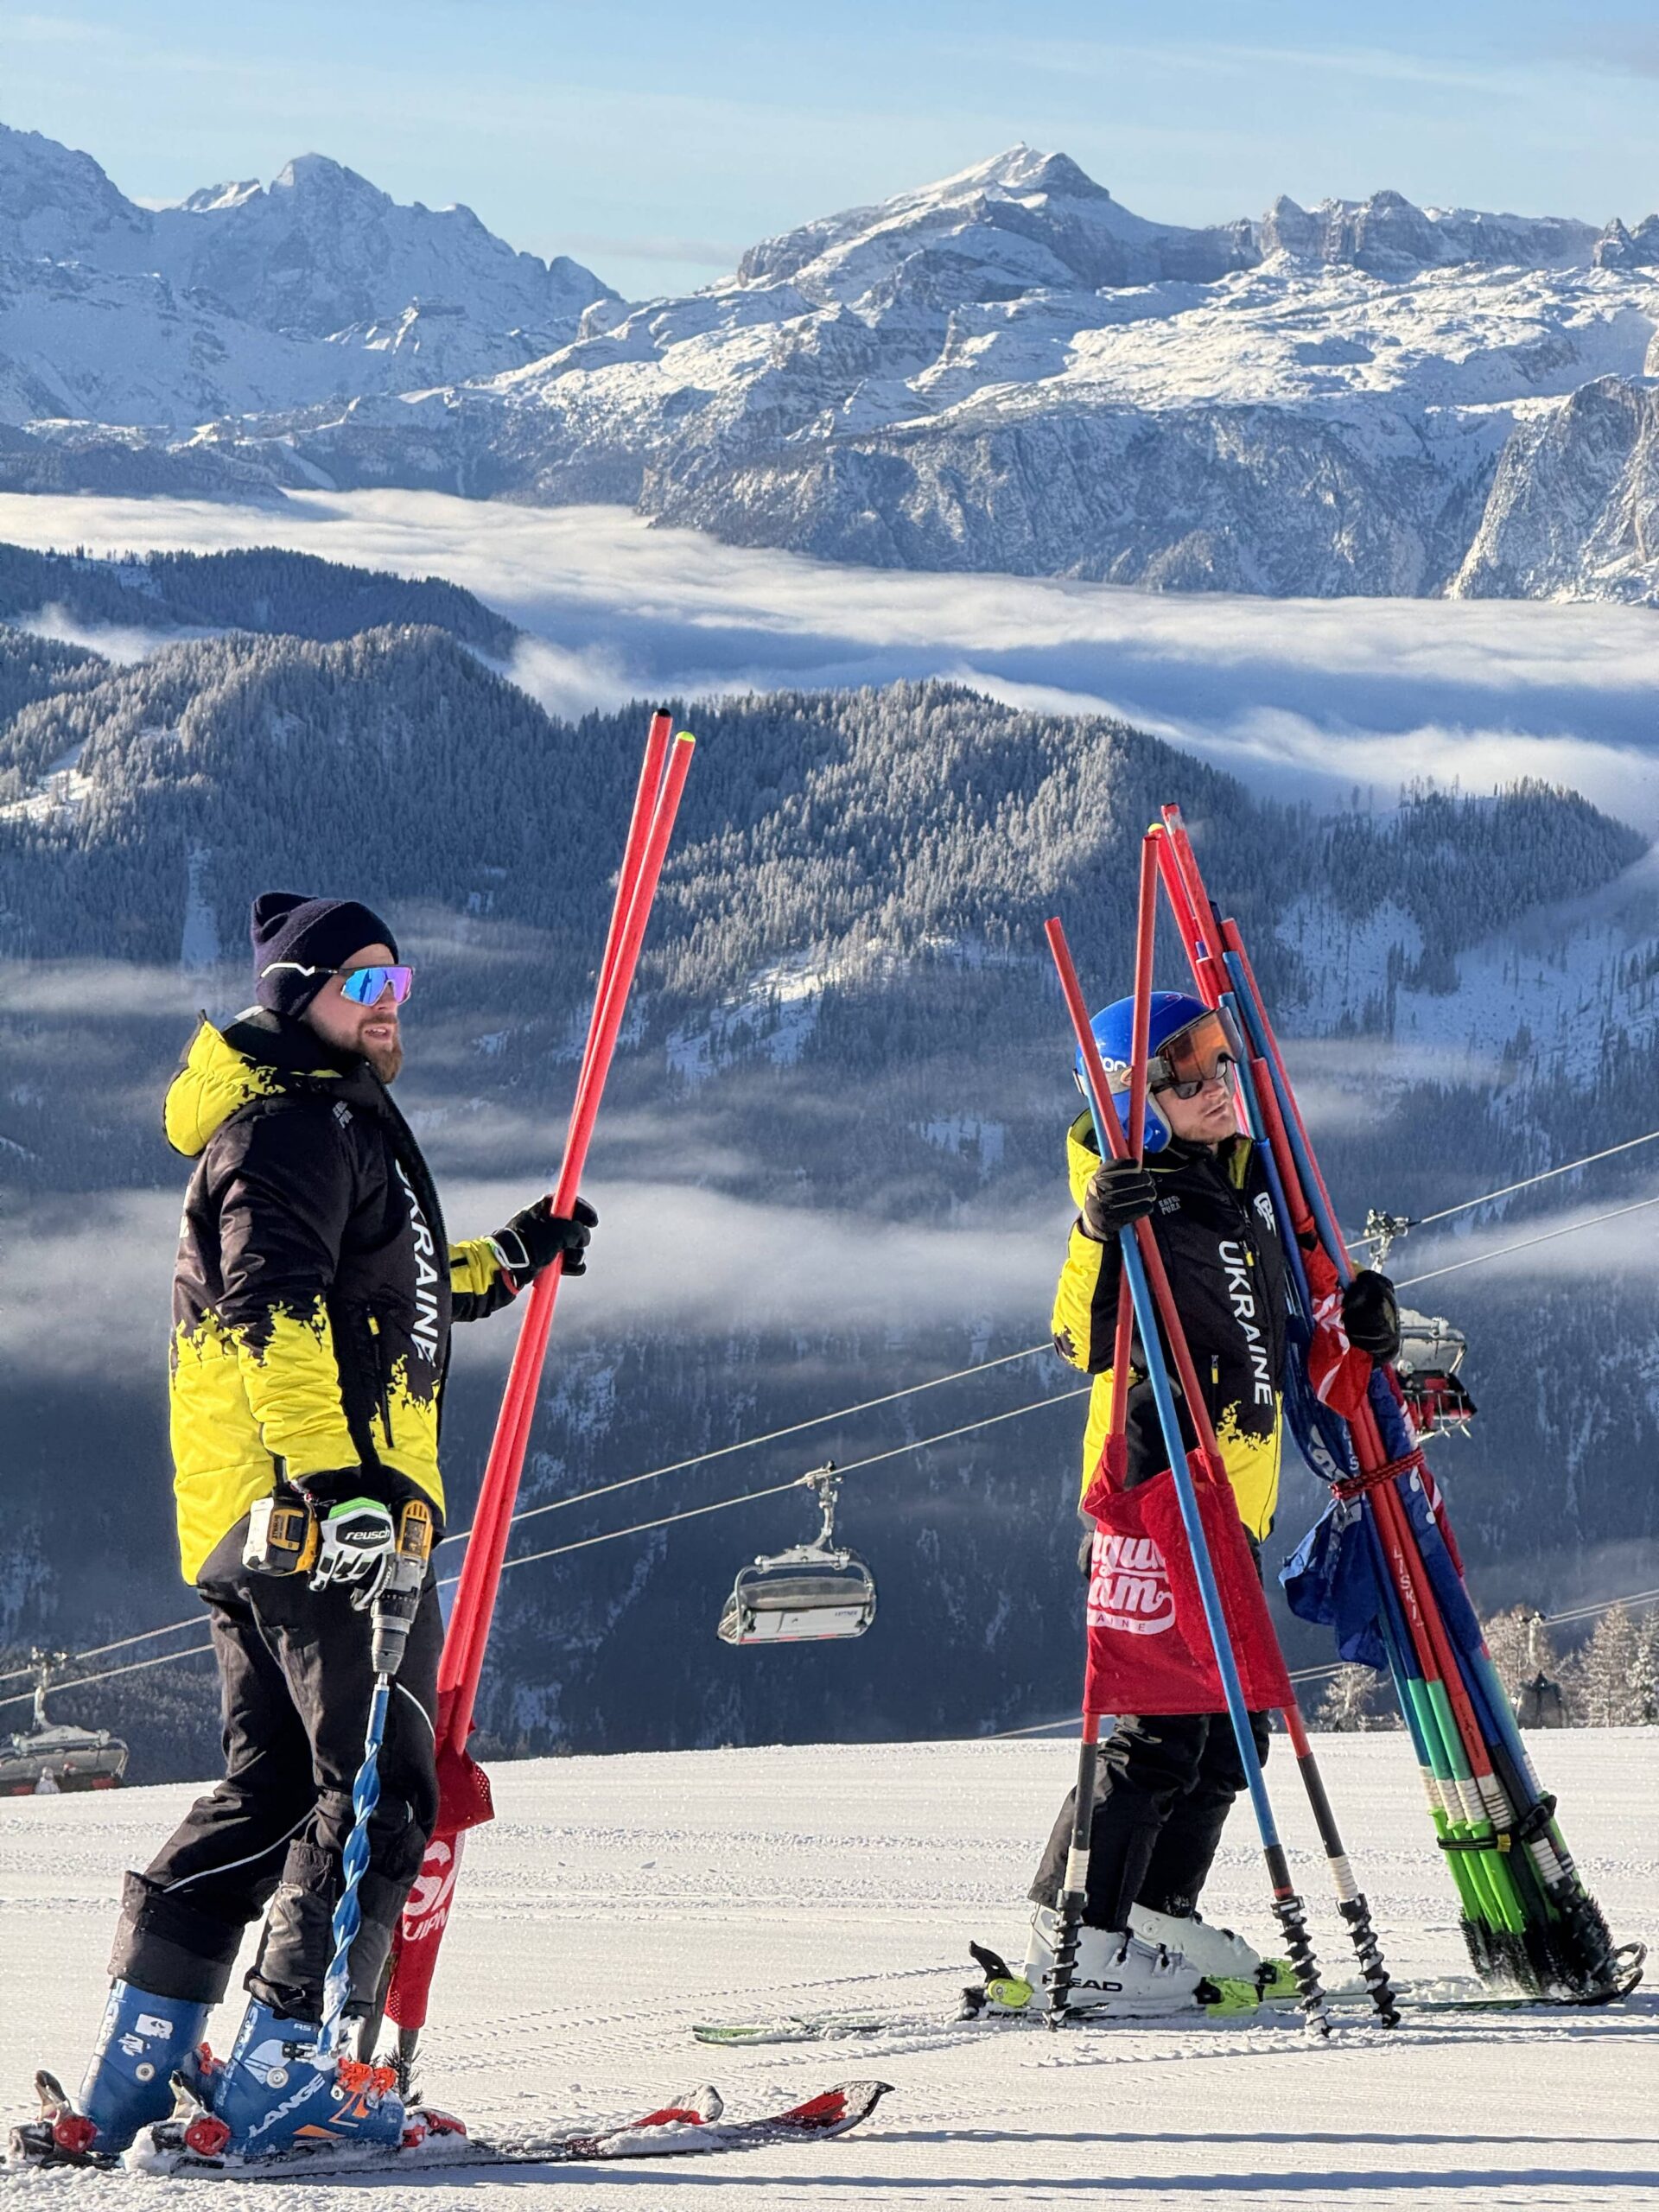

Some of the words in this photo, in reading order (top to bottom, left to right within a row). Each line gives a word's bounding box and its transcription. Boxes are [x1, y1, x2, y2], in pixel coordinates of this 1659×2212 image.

[1218, 1240, 1274, 1407] UKRAINE
[345, 1525, 391, 1541] reusch
[1393, 1545, 1417, 1620] LISKI
[1096, 1612, 1147, 1631] AINE
[249, 2072, 326, 2139] LANGE
